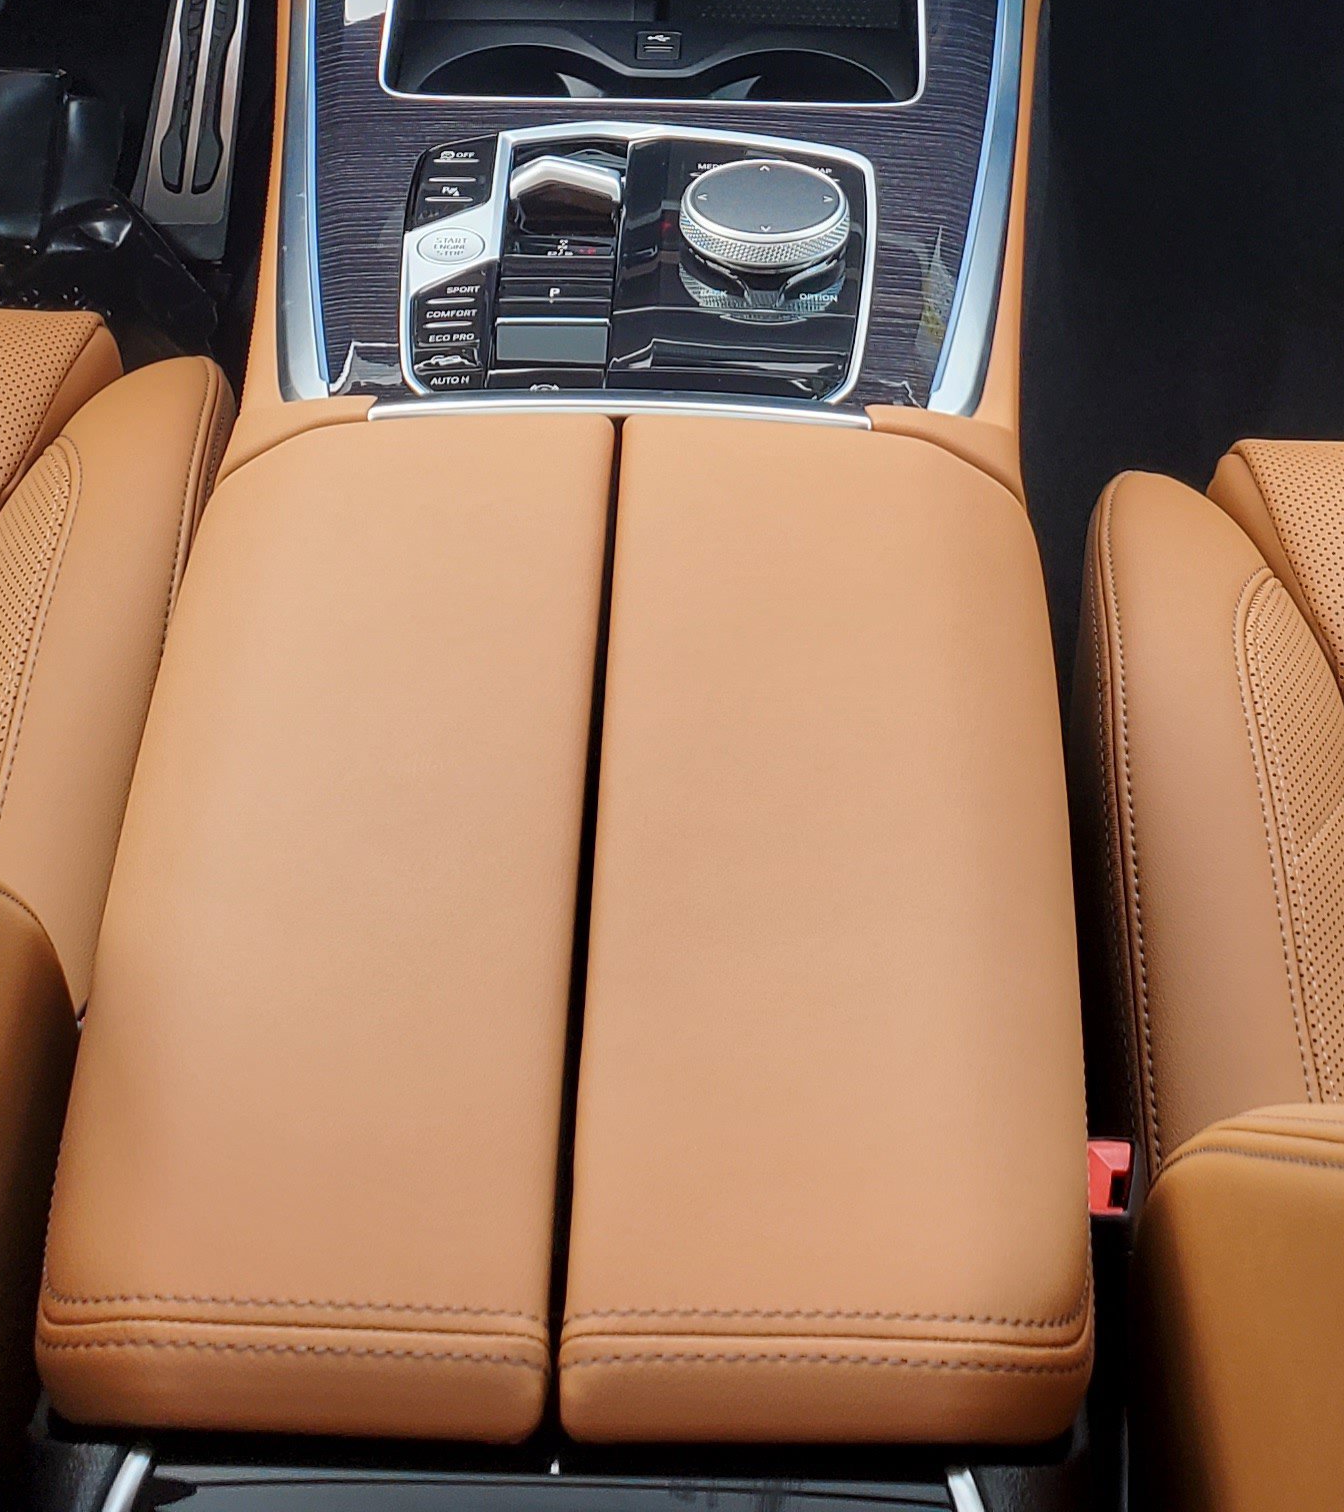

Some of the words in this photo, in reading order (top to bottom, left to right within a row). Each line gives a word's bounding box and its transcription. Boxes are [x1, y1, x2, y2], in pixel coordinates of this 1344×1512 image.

[447, 285, 480, 294] SPORT
[549, 288, 560, 297] P
[799, 293, 837, 302] OPTION
[426, 309, 477, 319] COMFORT
[428, 334, 451, 342] ECO
[453, 333, 475, 342] PRO
[430, 376, 460, 386] AUTO
